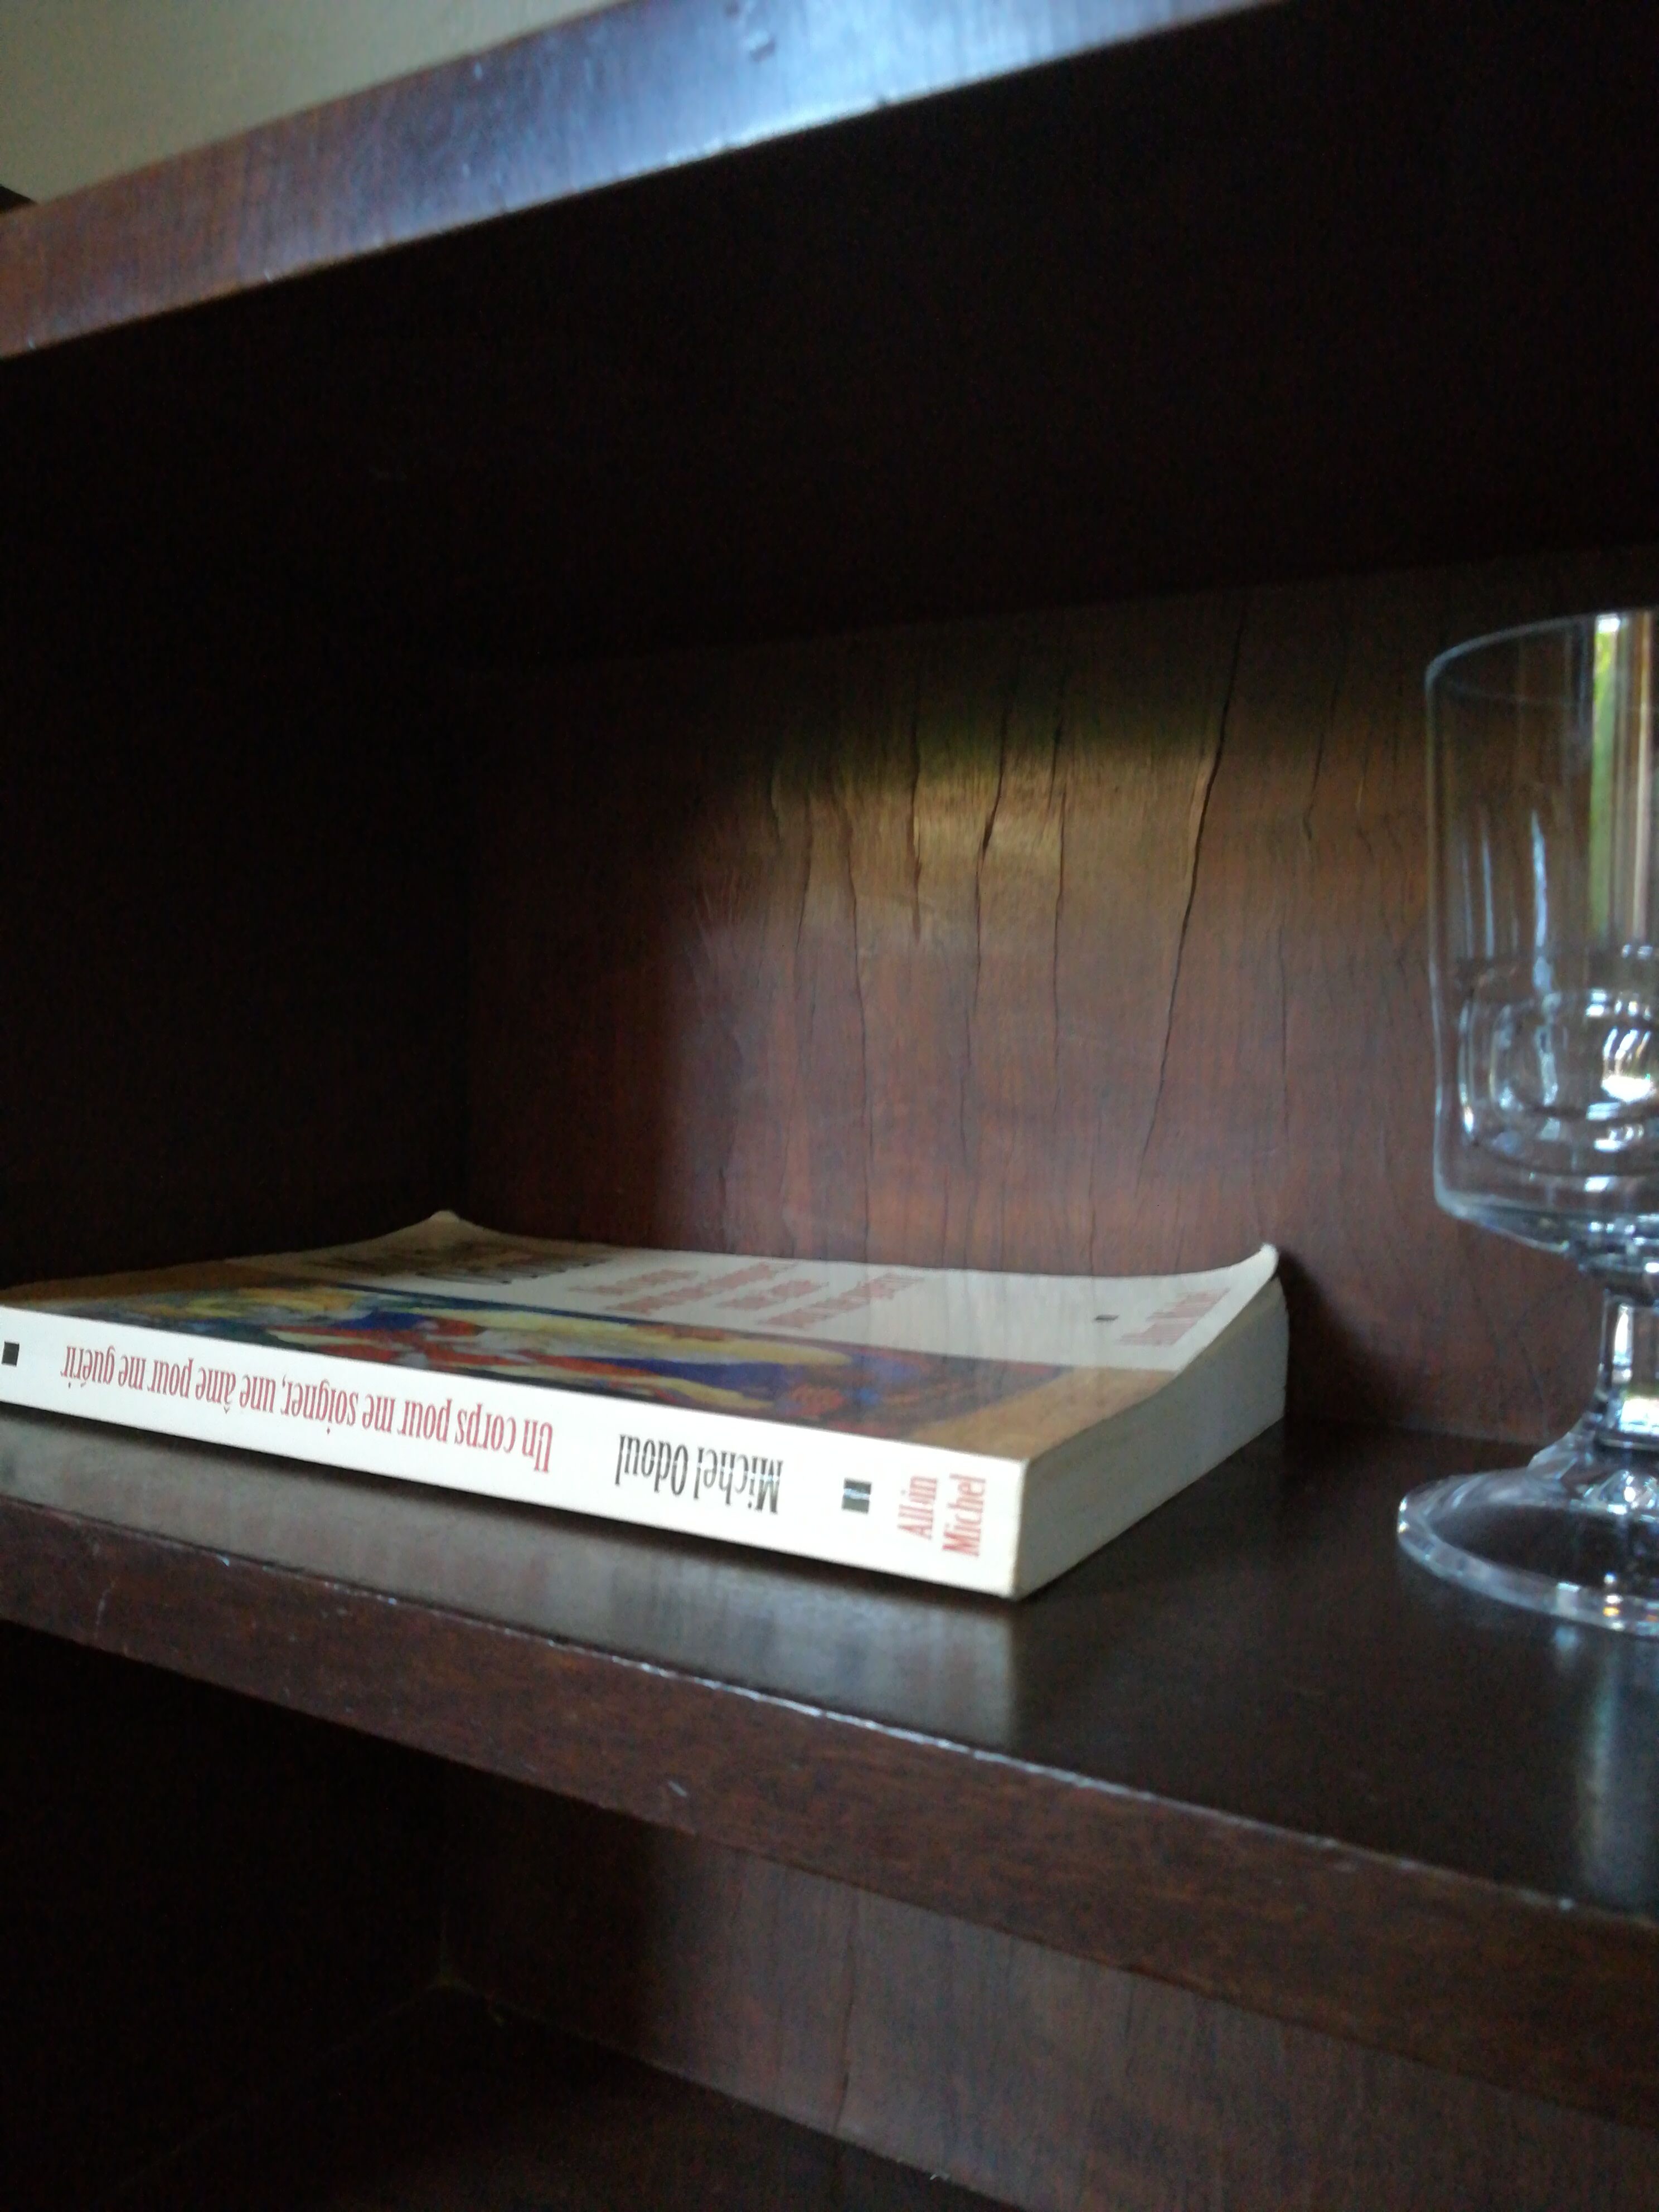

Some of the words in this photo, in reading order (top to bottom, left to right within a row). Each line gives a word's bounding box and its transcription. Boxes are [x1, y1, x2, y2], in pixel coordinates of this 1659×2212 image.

[60, 1345, 116, 1389] guérir
[118, 1355, 147, 1390] me
[147, 1357, 194, 1398] pour
[195, 1366, 237, 1414] âme
[239, 1374, 277, 1413] une
[280, 1374, 359, 1434] soigner,
[362, 1394, 396, 1435] me
[397, 1398, 453, 1442] pour
[454, 1403, 516, 1453] corps
[522, 1419, 554, 1472] Un
[614, 1434, 689, 1496] Odoul
[692, 1446, 784, 1514] Michel
[942, 1473, 986, 1557] Michel
